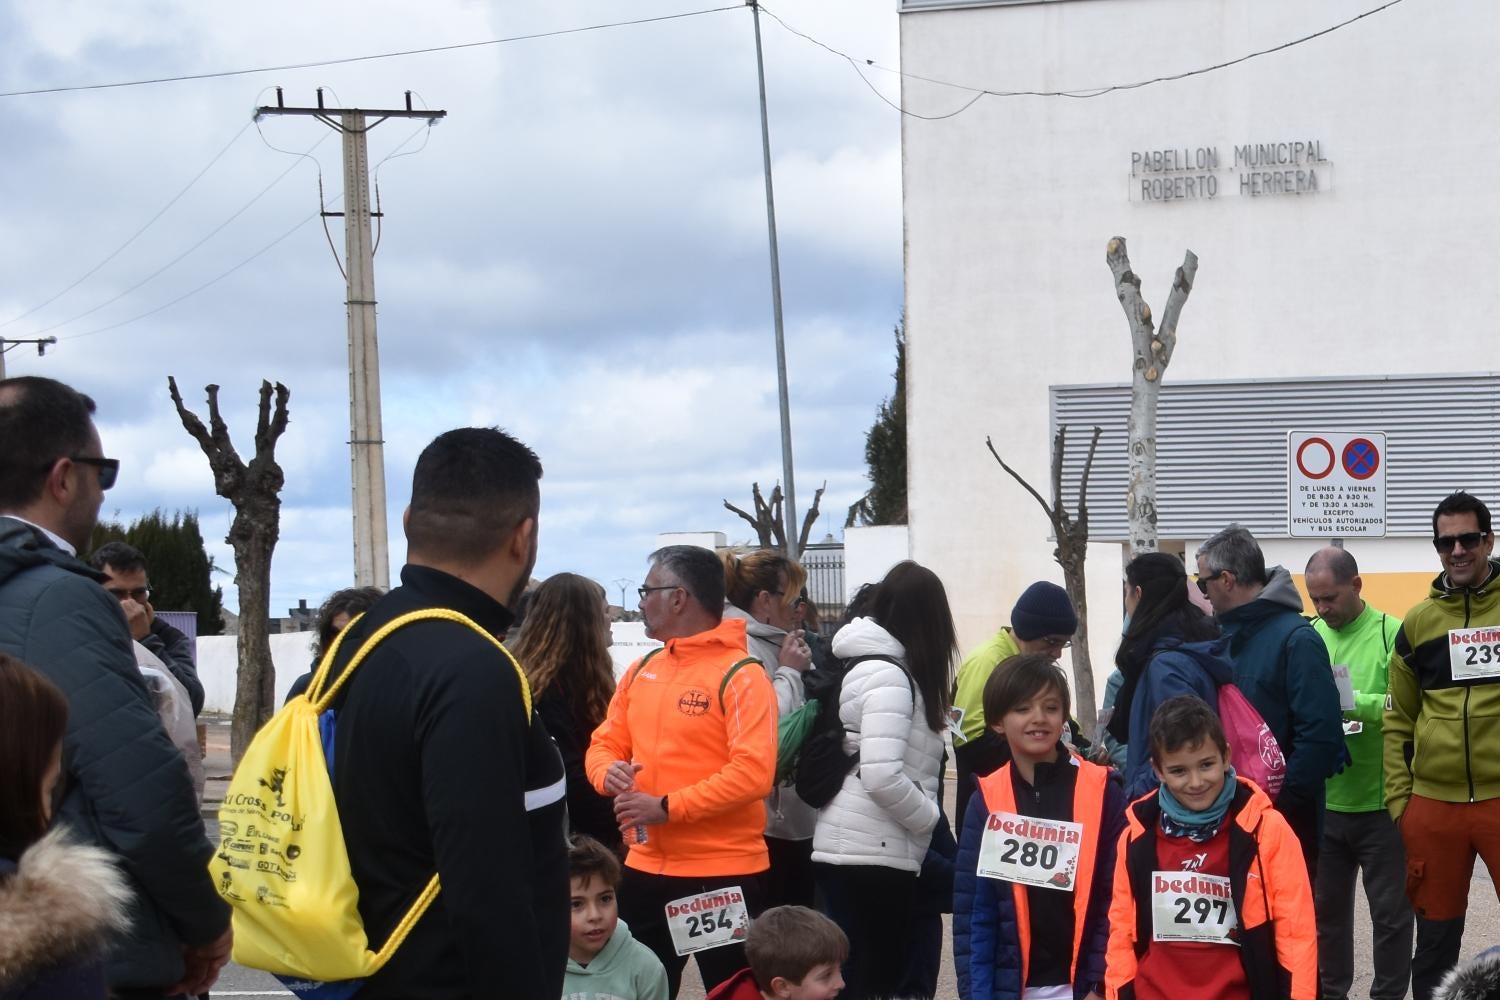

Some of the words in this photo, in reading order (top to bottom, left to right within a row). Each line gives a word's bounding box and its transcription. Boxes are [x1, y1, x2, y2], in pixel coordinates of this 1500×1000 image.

[1131, 147, 1217, 174] PABELLON
[1234, 140, 1327, 168] MUNICIPAL
[1141, 175, 1217, 201] ROBERTO
[1239, 169, 1319, 196] HERRERA
[987, 814, 1080, 844] bedunia
[1000, 838, 1059, 870] 280
[1154, 876, 1231, 898] beduni
[667, 891, 742, 918] bedunia
[1174, 897, 1228, 925] 297
[685, 908, 733, 938] 254
